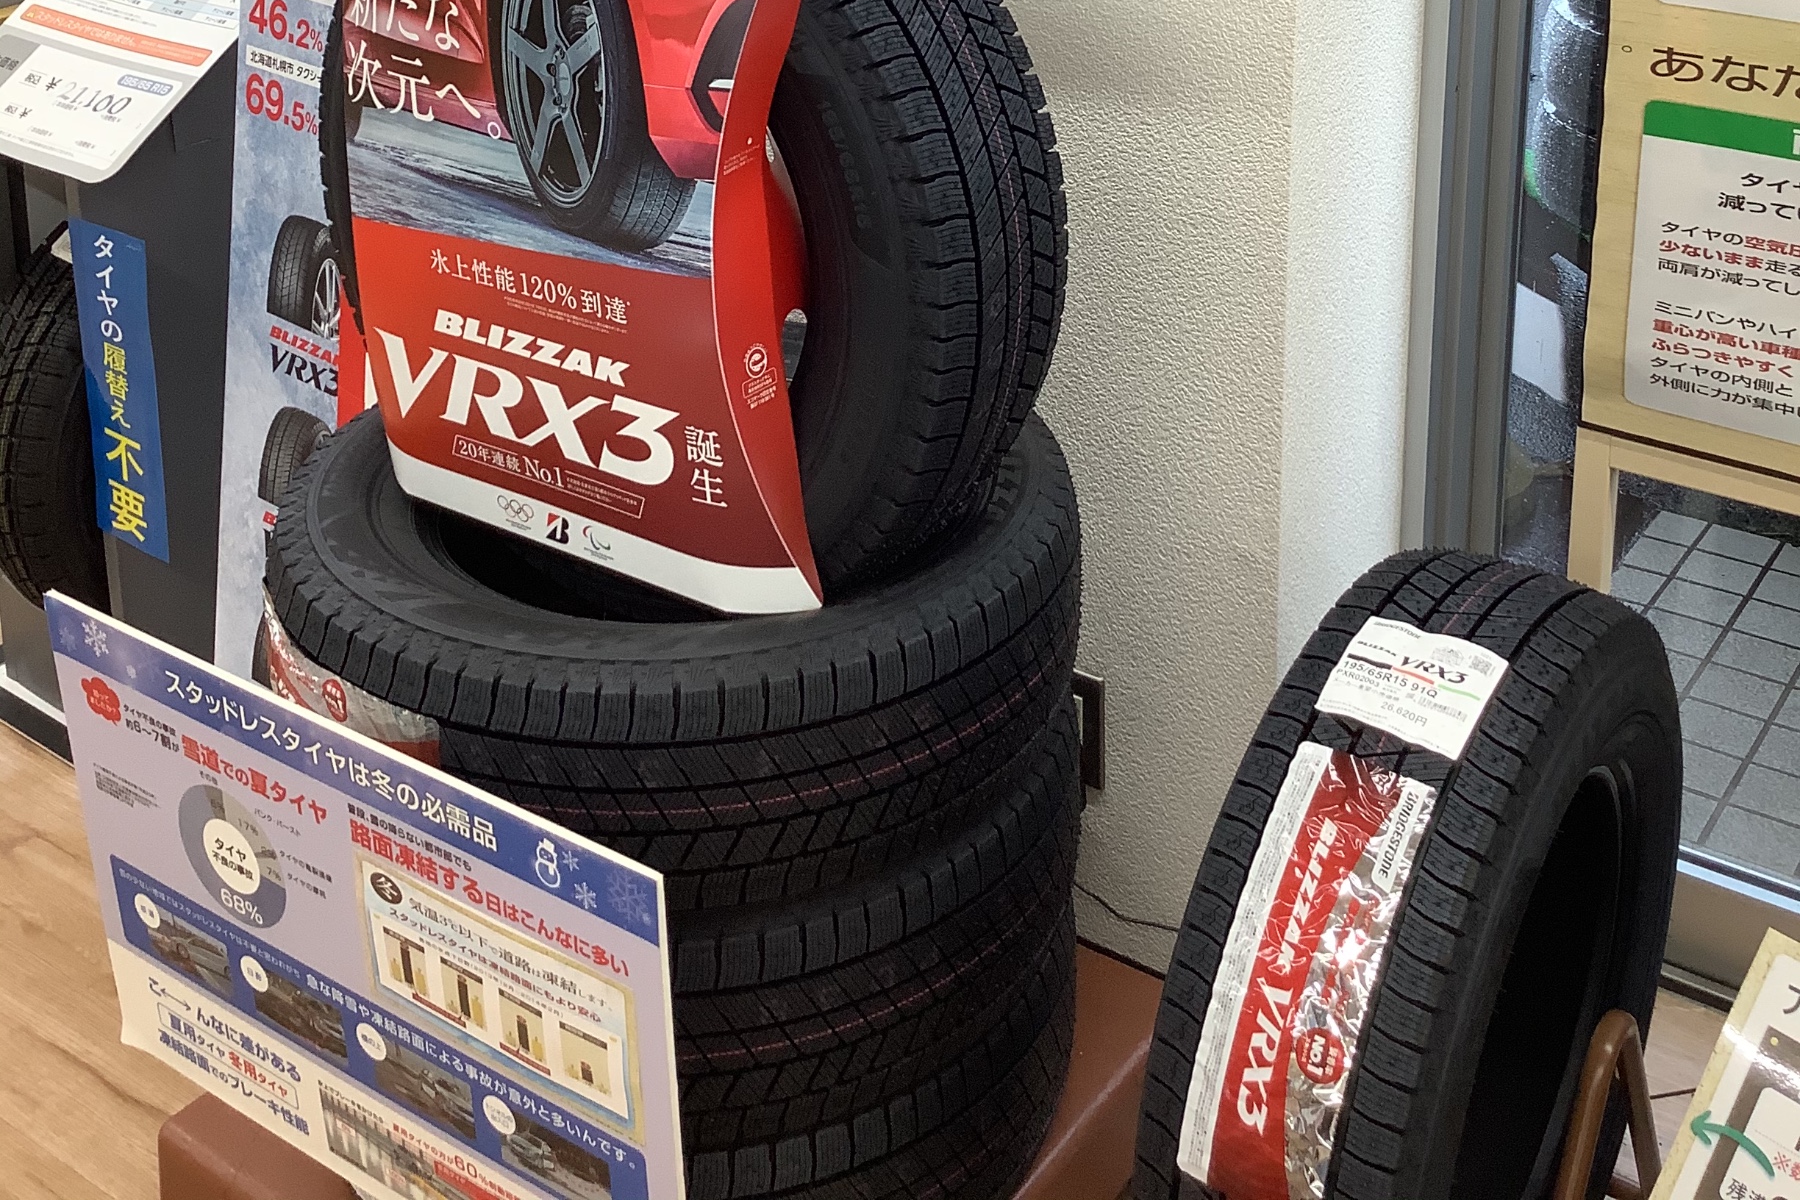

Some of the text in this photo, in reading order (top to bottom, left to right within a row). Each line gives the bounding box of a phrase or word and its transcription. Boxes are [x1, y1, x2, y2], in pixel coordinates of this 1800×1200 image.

[250, 50, 294, 74] 北海道札幌市
[346, 40, 501, 139] 次元へ。
[245, 73, 318, 136] 69.5%
[269, 325, 338, 365] BLIZZA
[1655, 301, 1797, 339] ミニバンやハイ
[434, 309, 630, 387] BLIZZAK
[1652, 338, 1794, 378] ふらつきやすく
[94, 235, 148, 542] タイヤの履替え不要
[1650, 373, 1800, 417] 外側に力が集中
[1651, 357, 1793, 397] タイヤの内側と
[373, 327, 681, 487] VRX3
[458, 440, 565, 488] 20年連続 No.1
[684, 425, 728, 508] 誕生
[1343, 661, 1438, 699] 195/65R15 91Q
[1400, 655, 1468, 684] VRX3
[164, 670, 498, 852] スタッドレスタイヤは冬の必需品
[181, 734, 327, 824] 雪道での夏タイヤ
[214, 837, 246, 862] タイヤ
[220, 887, 263, 925] 68%
[350, 818, 630, 977] 路面凍結する日はこんなに多い
[1278, 816, 1338, 974] BLIZZAK
[1237, 977, 1294, 1136] VRX3
